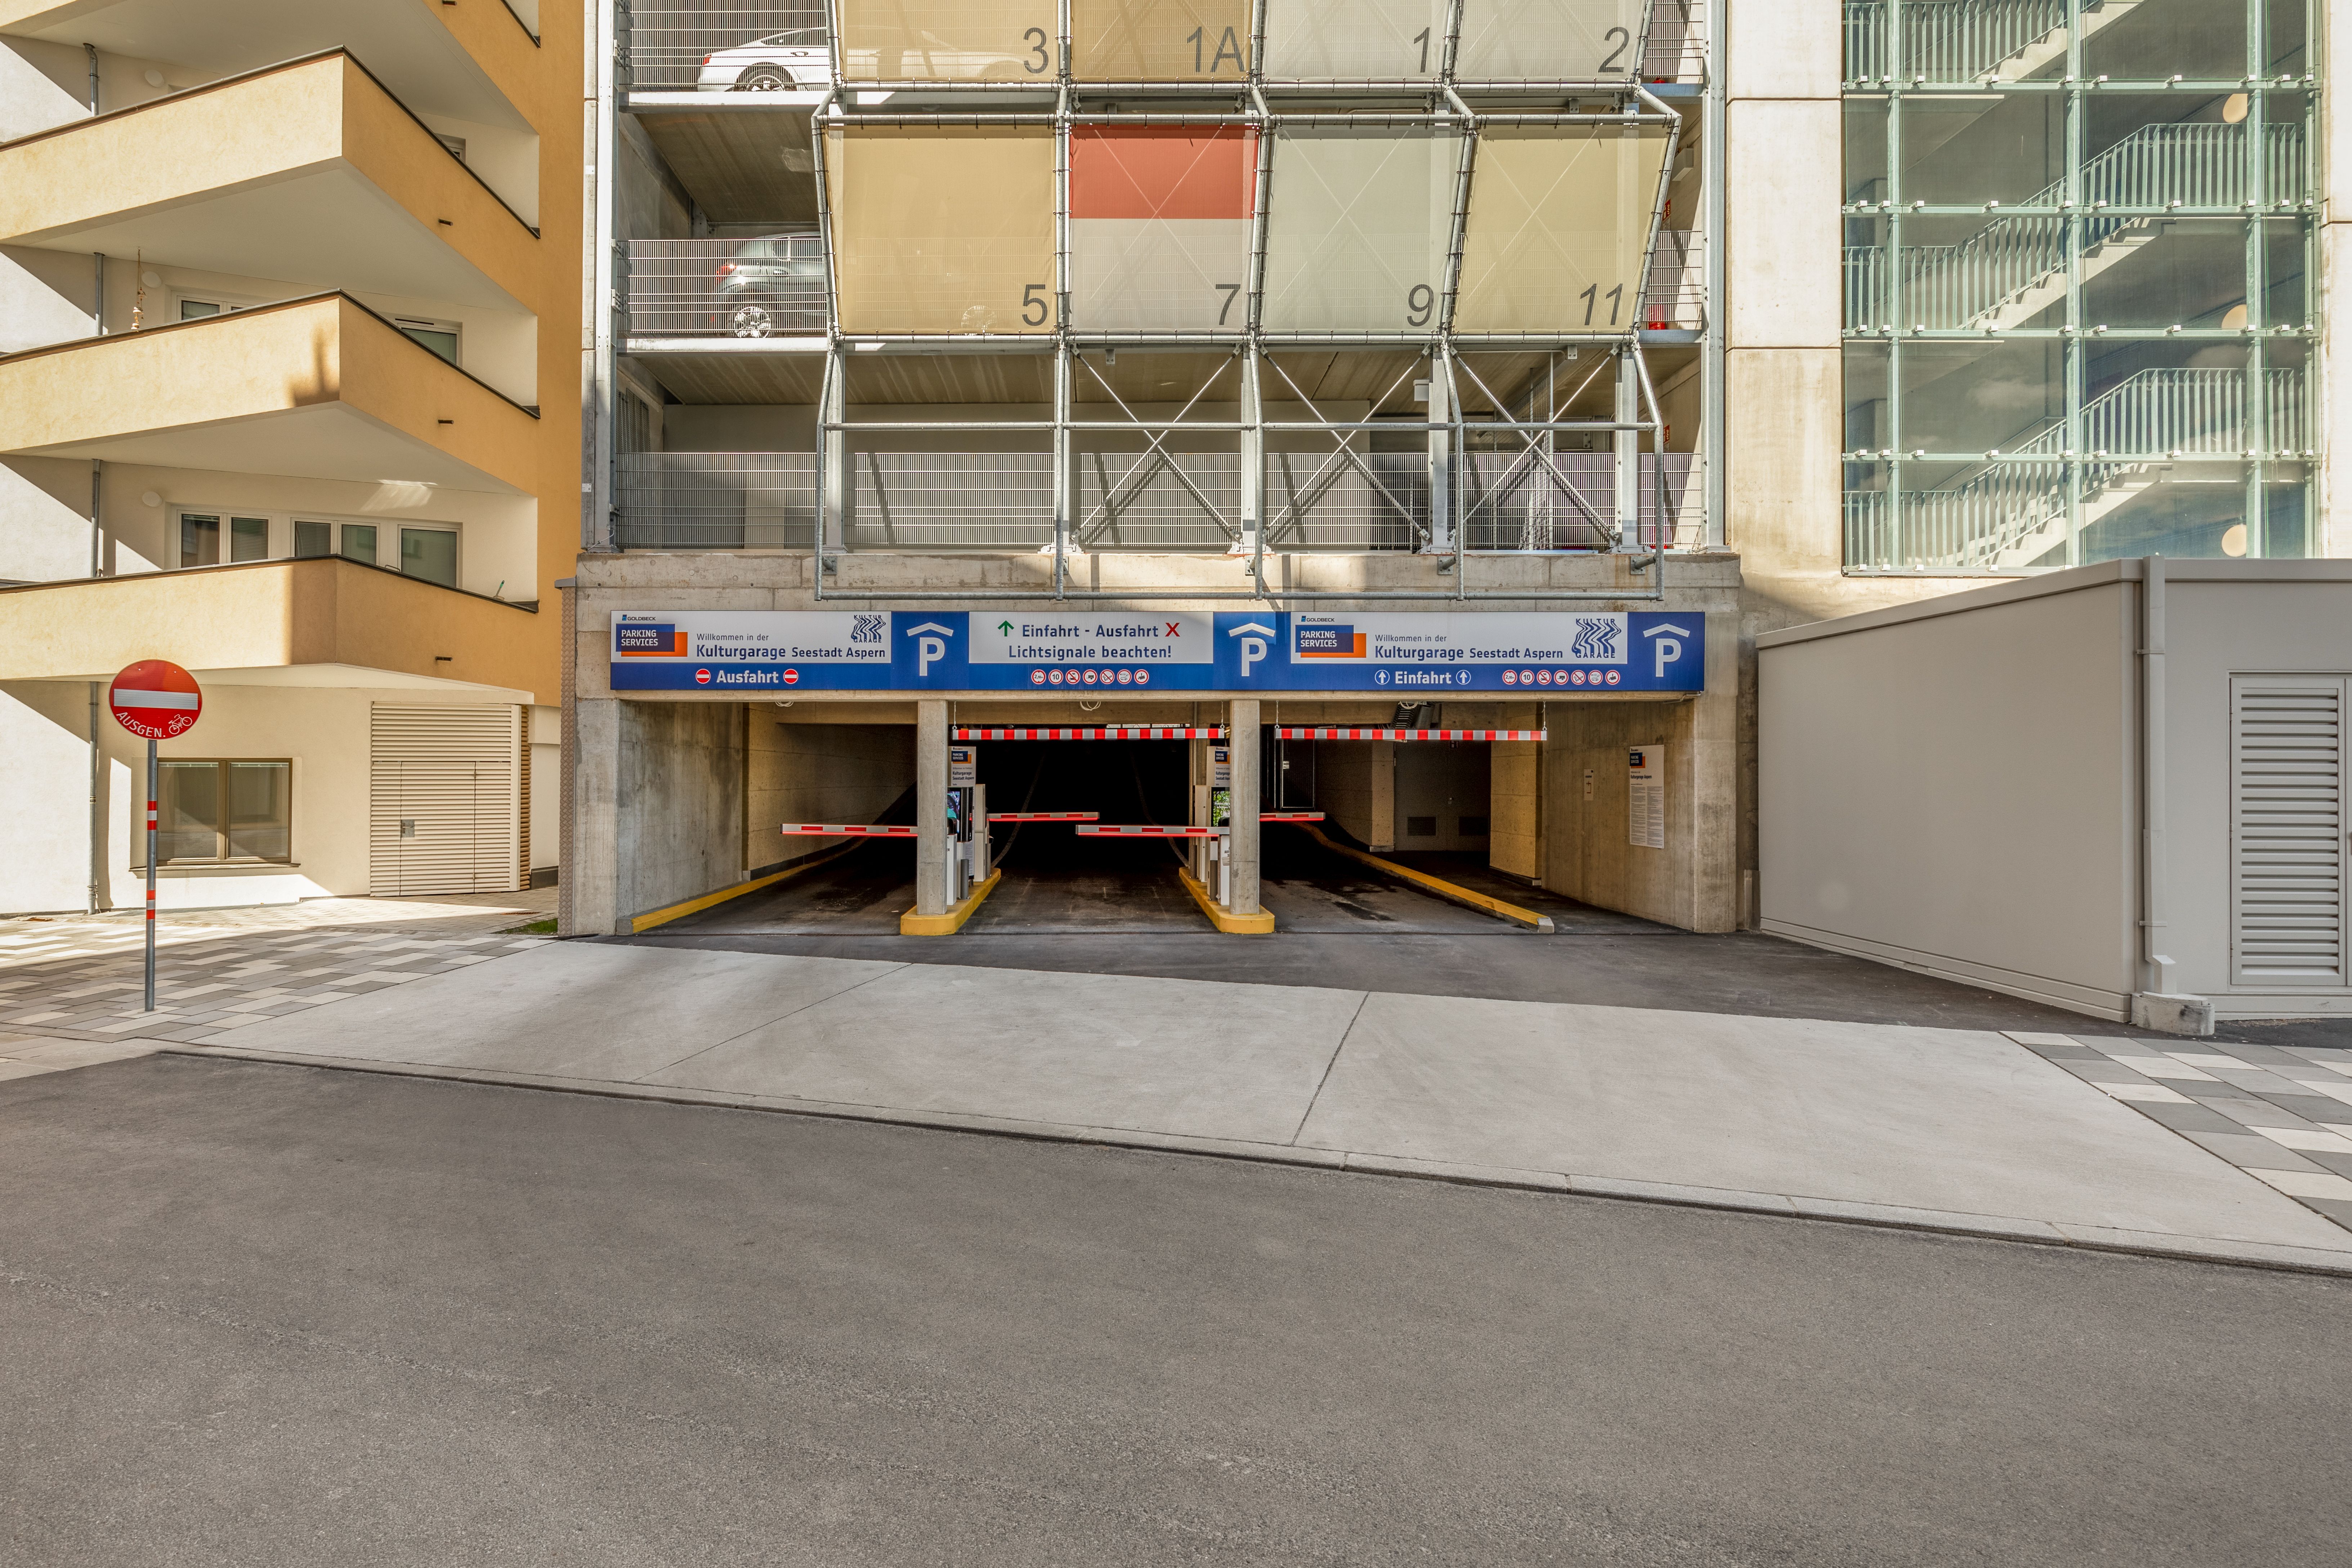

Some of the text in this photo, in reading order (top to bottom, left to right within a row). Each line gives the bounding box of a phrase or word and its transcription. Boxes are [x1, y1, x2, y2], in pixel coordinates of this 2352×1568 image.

[1024, 28, 1048, 73] 3
[1187, 27, 1245, 72] 1A
[1413, 27, 1430, 72] 1
[1598, 27, 1629, 72] 2
[1022, 285, 1047, 326] 5
[1216, 284, 1240, 325] 7
[1407, 284, 1434, 326] 9
[1580, 283, 1622, 325] 11
[1023, 625, 1079, 637] Einfahrt
[1096, 625, 1158, 637] Ausfahrt
[697, 644, 885, 660] Kulturgarage Seestadt Aspern
[920, 637, 945, 676] P
[1009, 645, 1171, 661] Lichtsignale beachten!
[1242, 638, 1267, 676] P
[1376, 645, 1563, 661] Kulturgarage Seestadt Aspern
[1656, 638, 1681, 677] P
[716, 670, 778, 683] Ausfahrt
[1395, 671, 1452, 684] Einfahrt
[116, 712, 166, 737] AUSGEN.
